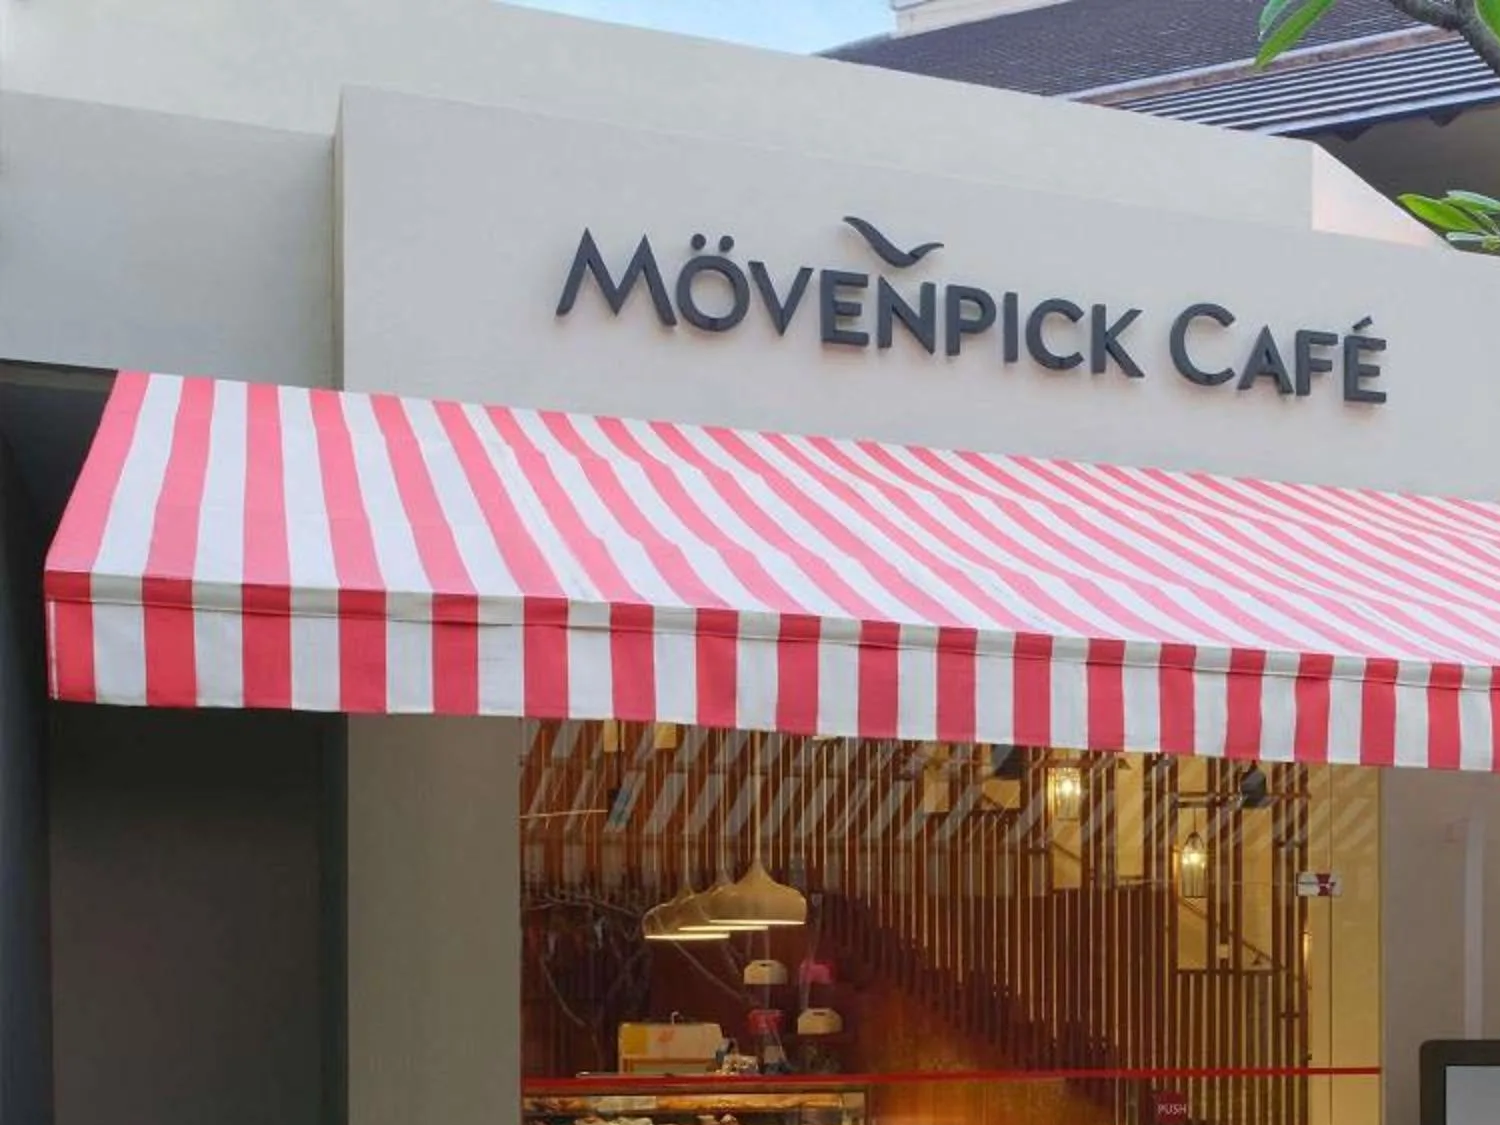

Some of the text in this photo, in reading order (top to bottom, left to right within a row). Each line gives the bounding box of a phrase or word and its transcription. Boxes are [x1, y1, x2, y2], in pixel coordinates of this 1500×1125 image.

[555, 226, 1388, 404] MÖVENPICK CAFÉ
[1157, 1103, 1187, 1115] PUSH
